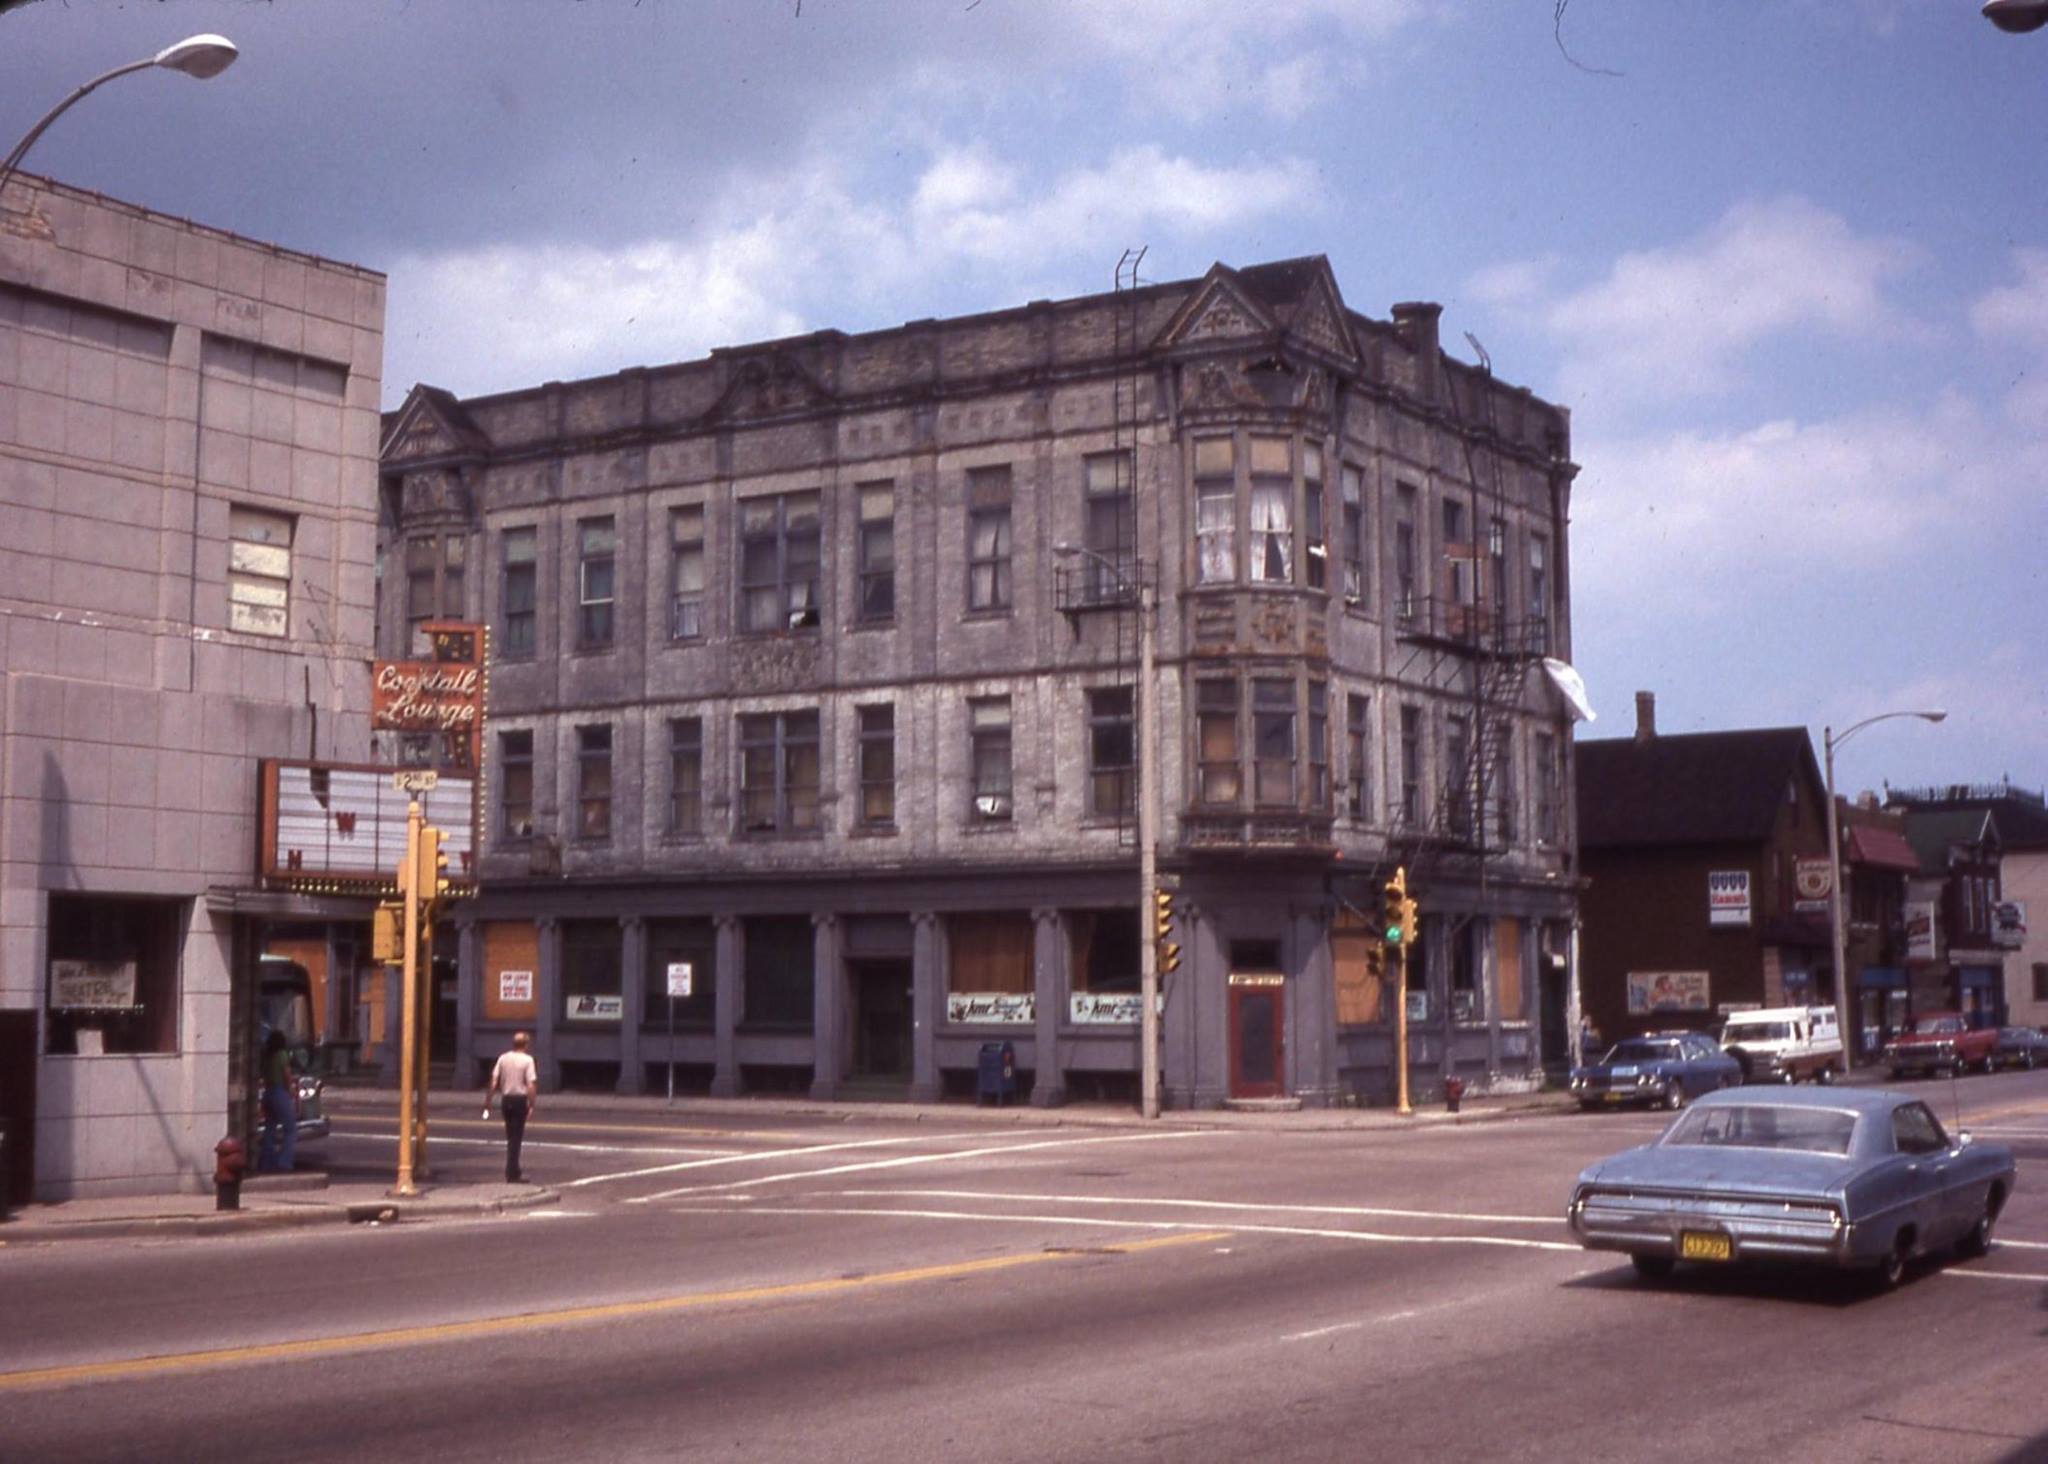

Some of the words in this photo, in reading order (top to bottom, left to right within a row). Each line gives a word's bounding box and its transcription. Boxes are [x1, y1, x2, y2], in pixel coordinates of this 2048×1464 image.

[378, 665, 478, 698] Cocktail
[376, 694, 475, 729] Lounge
[335, 811, 356, 840] W
